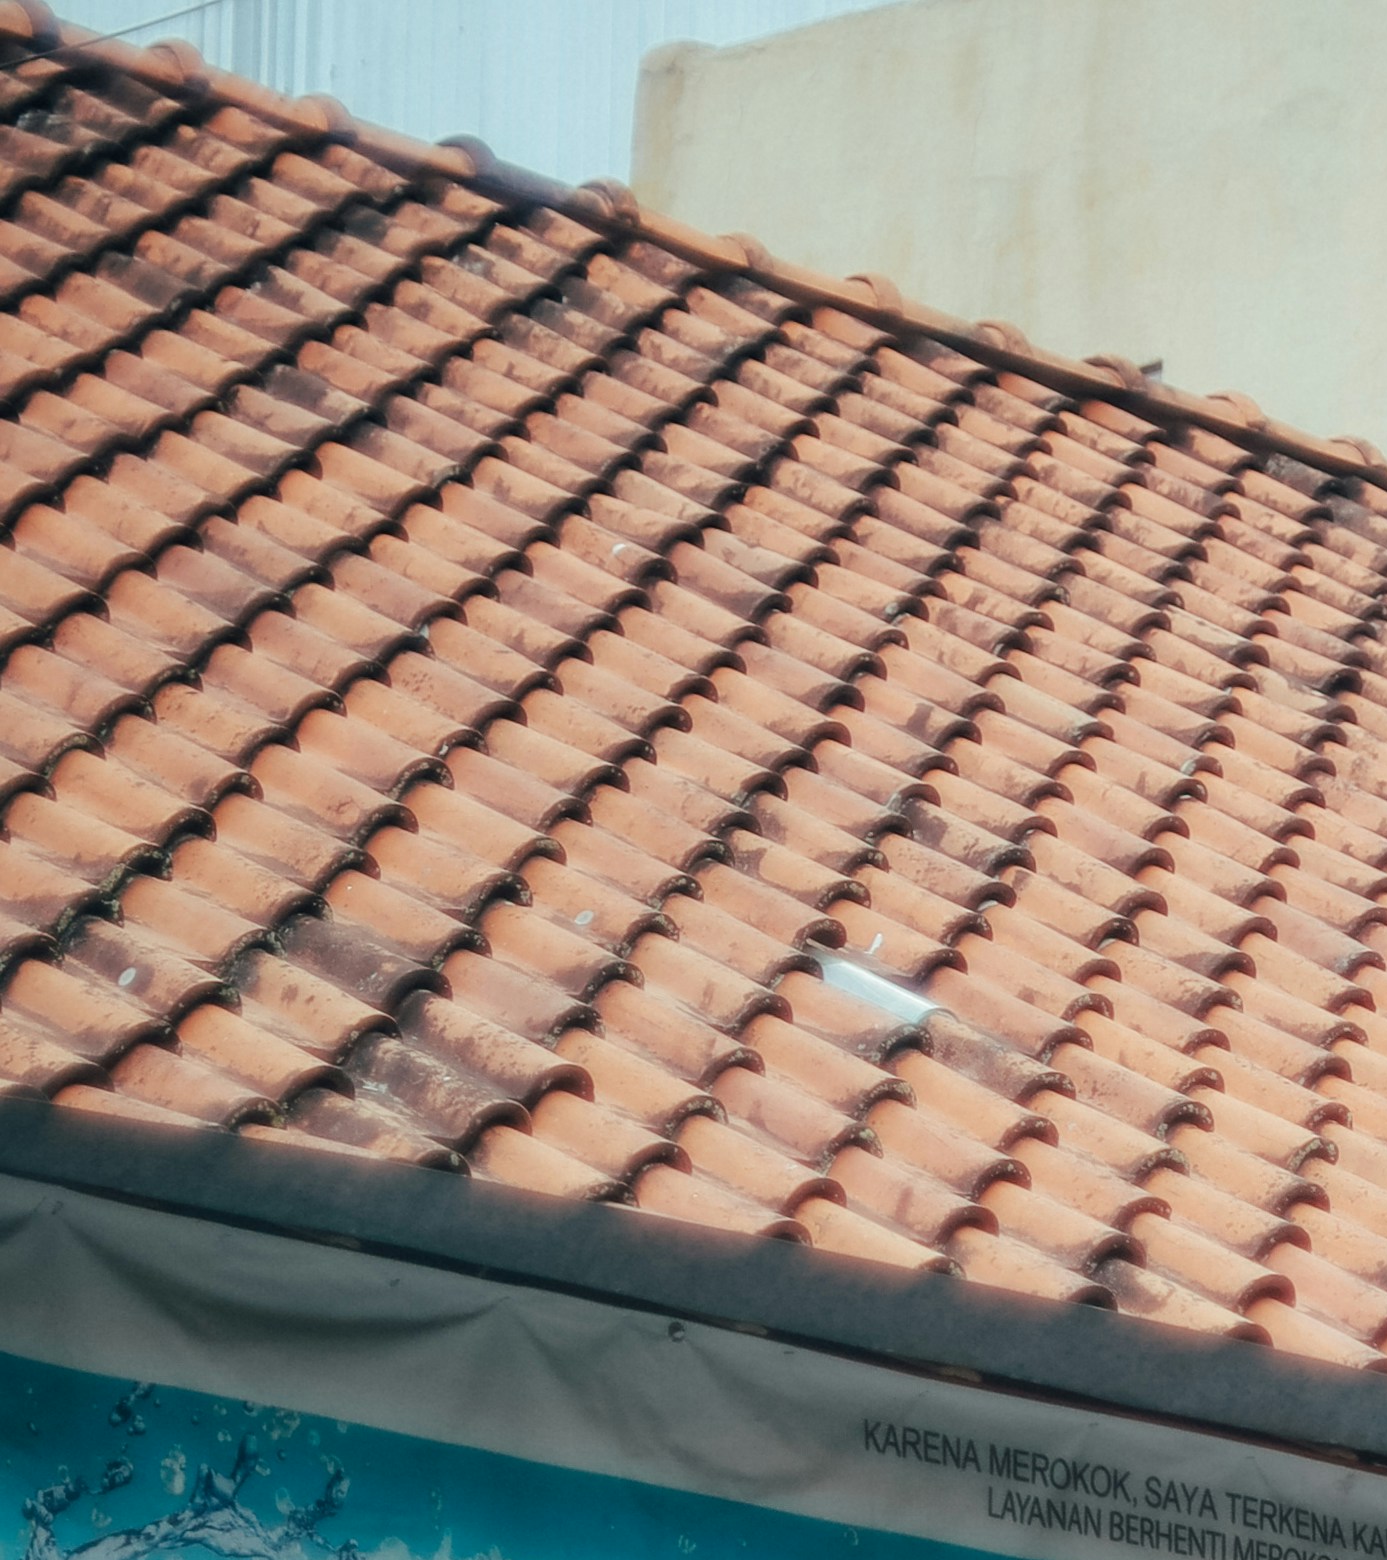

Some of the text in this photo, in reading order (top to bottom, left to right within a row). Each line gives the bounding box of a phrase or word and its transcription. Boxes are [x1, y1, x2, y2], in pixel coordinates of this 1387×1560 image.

[863, 1418, 982, 1473] KARENA
[989, 1443, 1137, 1507] MEROKOK,
[1144, 1475, 1218, 1520] SAYA
[1226, 1492, 1346, 1549] TERKENA
[987, 1486, 1101, 1538] LAYANAN
